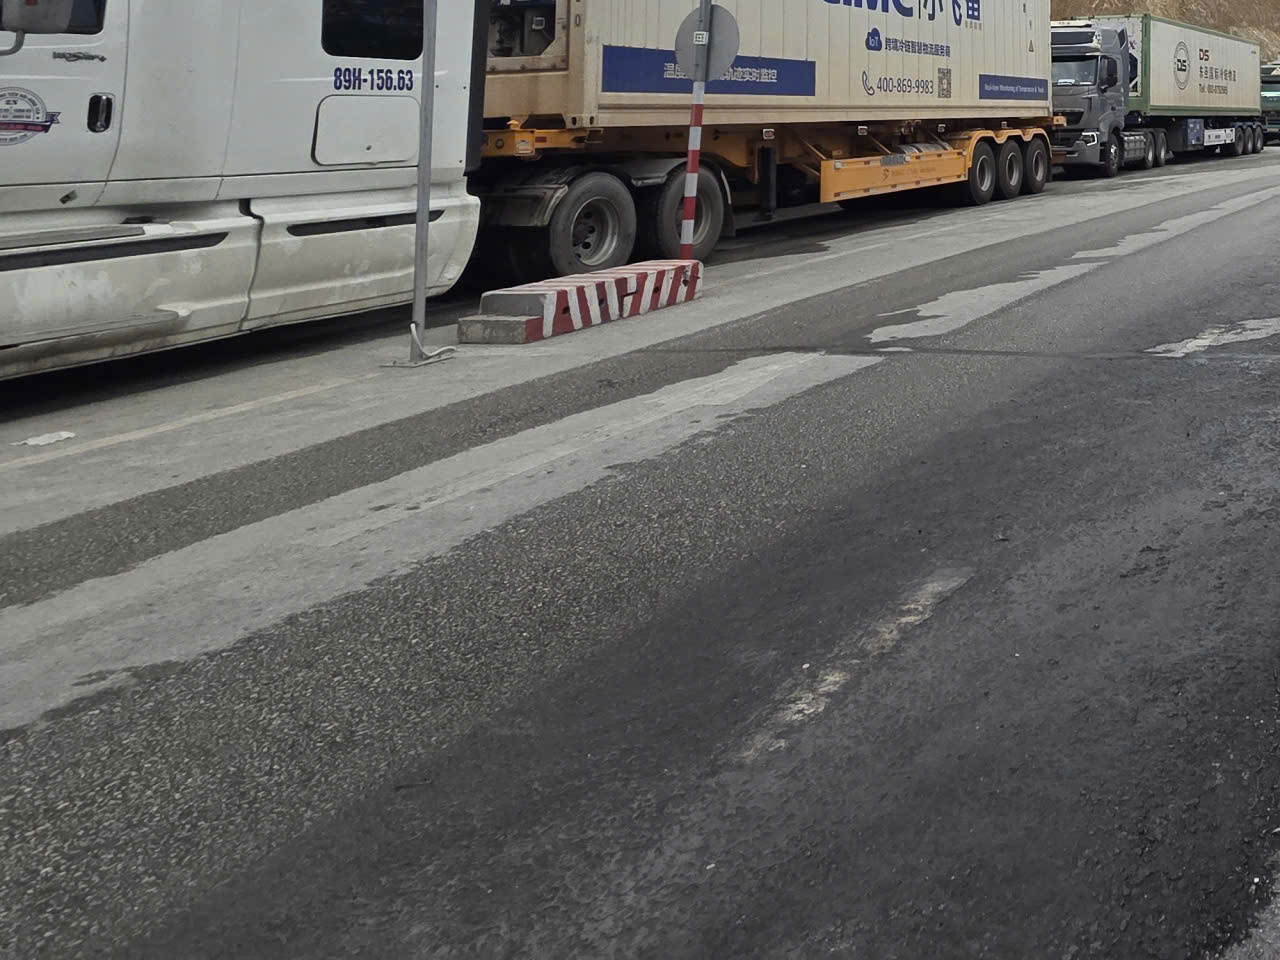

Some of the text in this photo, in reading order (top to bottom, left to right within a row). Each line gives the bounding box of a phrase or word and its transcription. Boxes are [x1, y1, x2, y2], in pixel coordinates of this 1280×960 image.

[1199, 48, 1210, 62] DS
[333, 67, 414, 91] 89H-156.63
[876, 76, 934, 95] 400-869-9983
